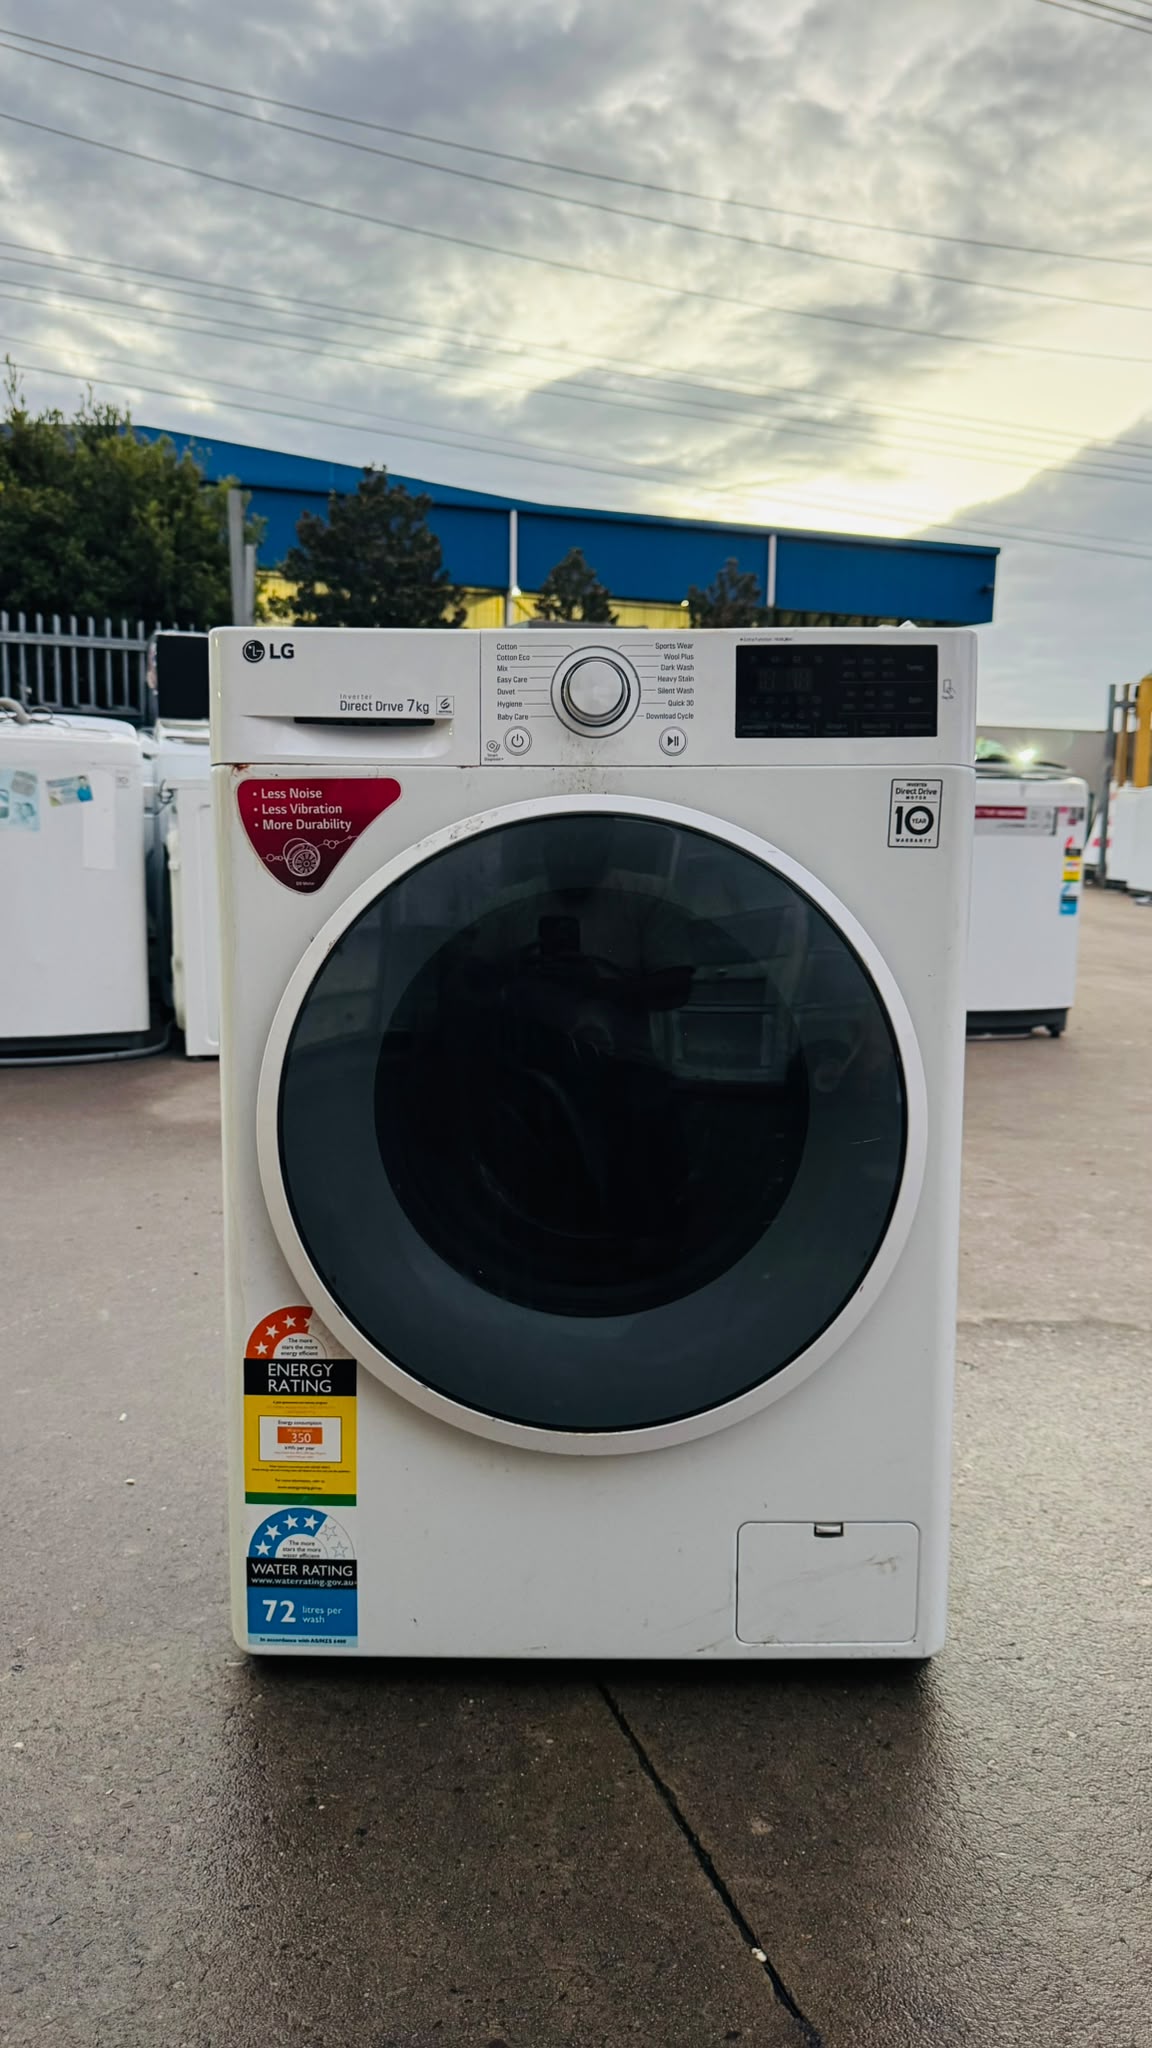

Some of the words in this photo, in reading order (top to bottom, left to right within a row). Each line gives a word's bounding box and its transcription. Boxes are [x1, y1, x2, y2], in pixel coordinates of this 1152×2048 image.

[269, 643, 294, 659] LG
[658, 676, 677, 684] Heavy
[340, 701, 372, 712] Direct
[376, 701, 404, 712] Drive
[406, 699, 430, 714] 7kg
[498, 713, 513, 721] Baby
[677, 712, 694, 720] Cycle
[261, 788, 286, 799] Less
[290, 788, 322, 798] Noise
[262, 804, 287, 814] Less
[290, 803, 342, 814] Vibration
[263, 819, 293, 830] More
[296, 818, 352, 832] Durability
[895, 805, 934, 835] 10
[268, 1363, 334, 1377] ENERGY
[268, 1379, 332, 1393] RATING
[291, 1433, 311, 1443] 350
[252, 1563, 298, 1575] WATER
[302, 1565, 353, 1576] RATING
[262, 1600, 296, 1623] 72
[302, 1606, 324, 1614] litres
